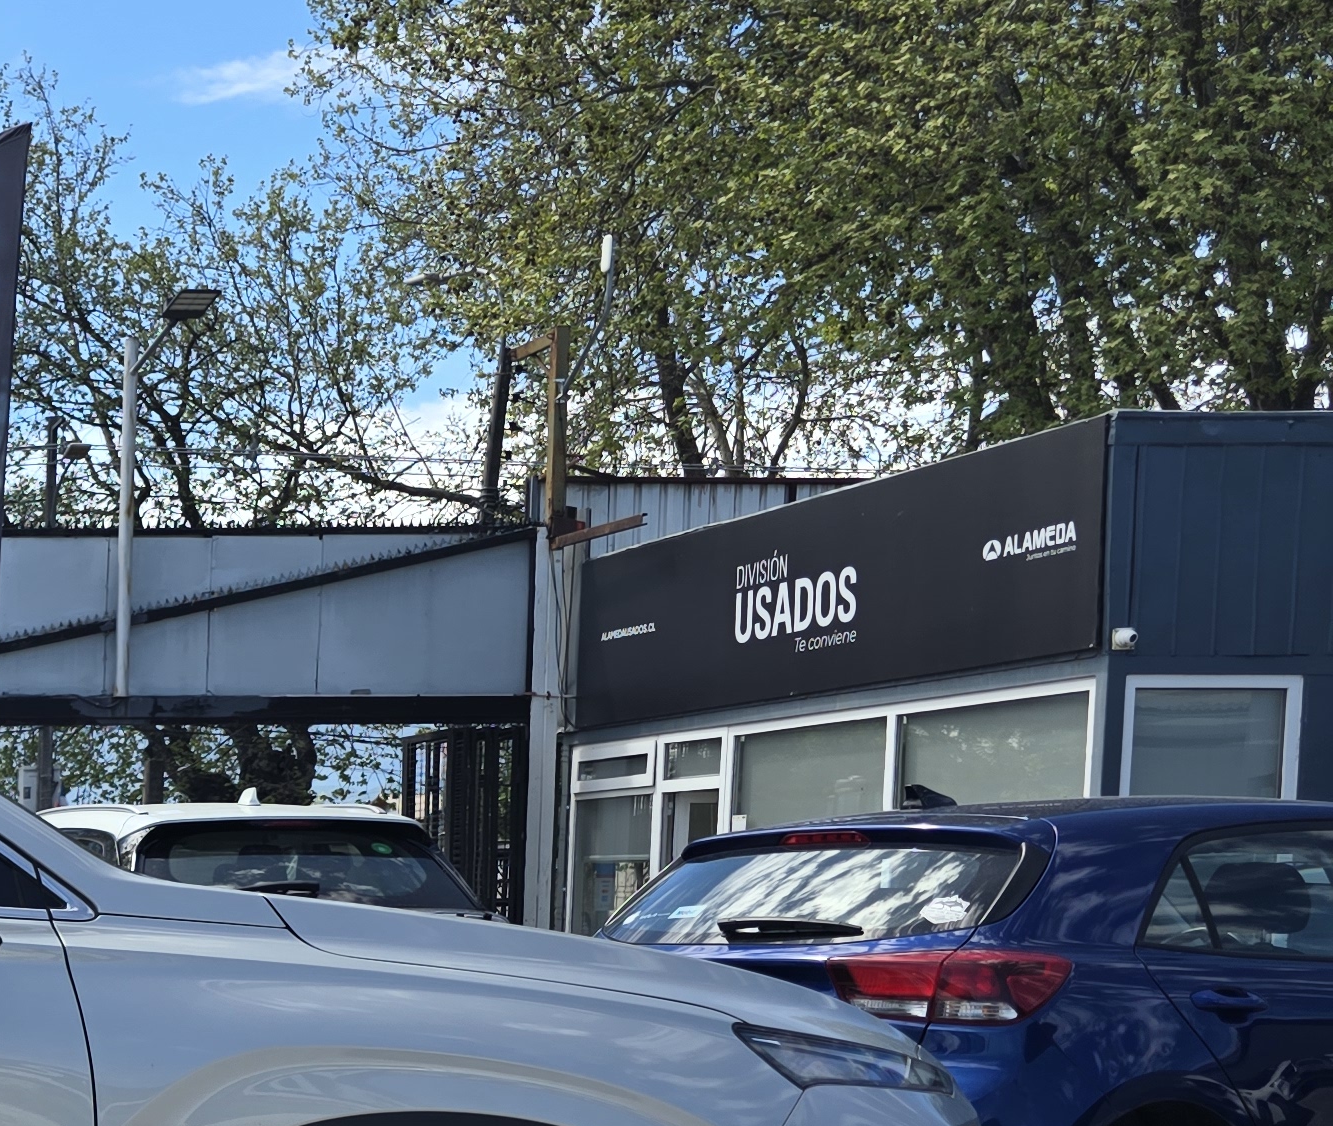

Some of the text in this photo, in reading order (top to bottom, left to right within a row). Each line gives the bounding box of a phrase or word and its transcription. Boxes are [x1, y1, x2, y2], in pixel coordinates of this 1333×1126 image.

[1002, 520, 1077, 557] ALAMEDA
[736, 549, 788, 590] DIVISIÓN
[734, 565, 857, 644] USADOS
[794, 629, 857, 653] Te conviene
